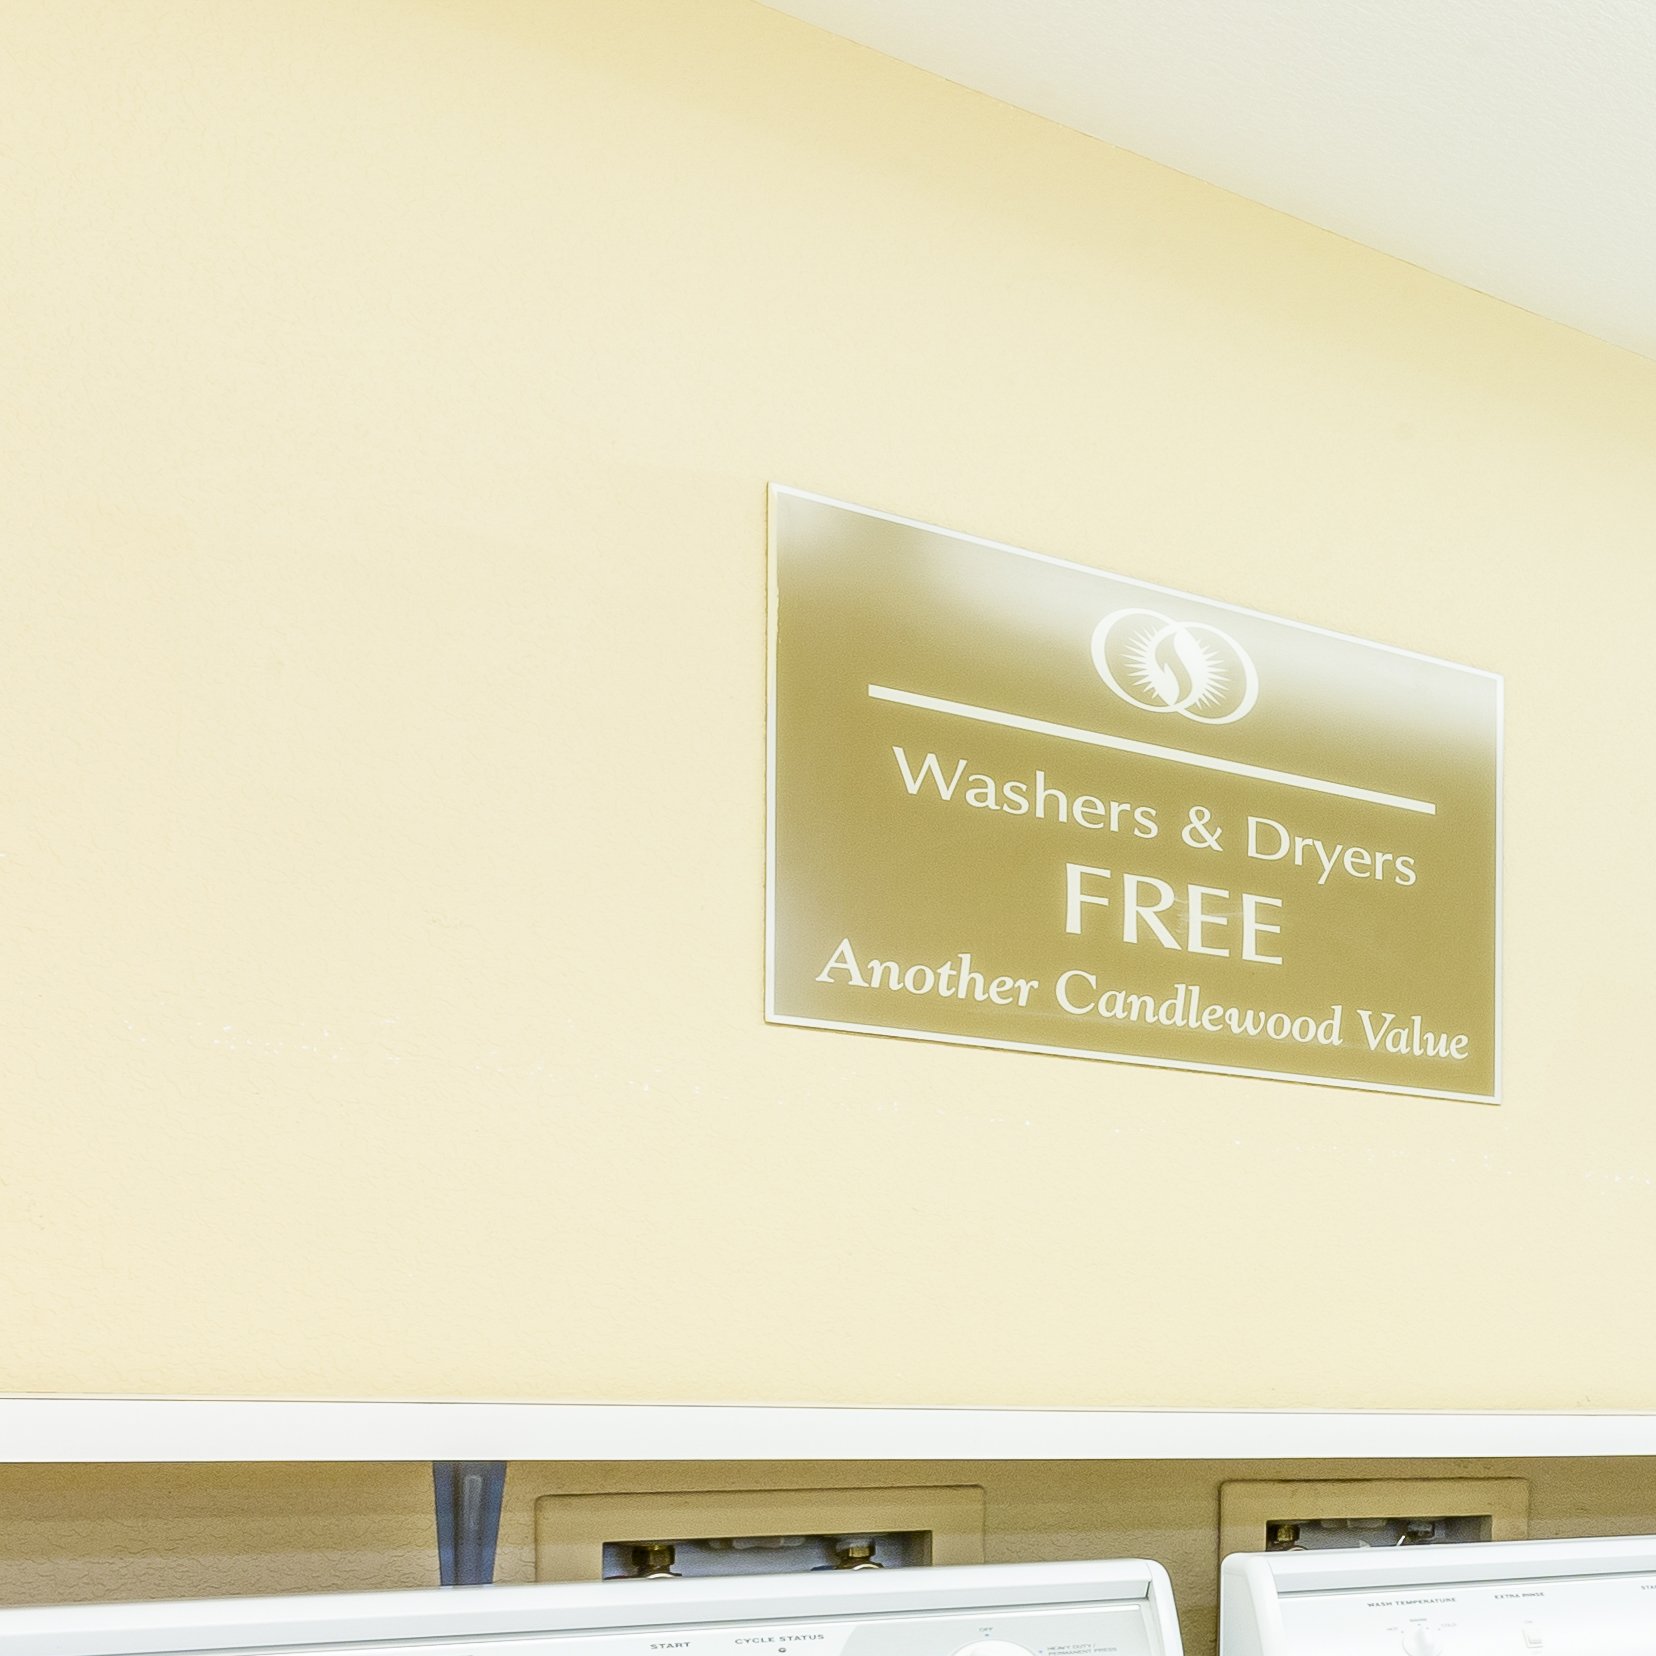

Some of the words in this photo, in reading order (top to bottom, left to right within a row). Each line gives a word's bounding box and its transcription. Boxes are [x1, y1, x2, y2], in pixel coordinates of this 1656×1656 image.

[893, 746, 1158, 839] Washers
[1181, 805, 1223, 852] &
[1247, 817, 1417, 886] Dryers
[1064, 862, 1283, 965] FREE
[815, 938, 1038, 1008] Another
[1055, 969, 1343, 1047] Candlewood
[1357, 1010, 1469, 1060] Value
[649, 1641, 691, 1650] START
[734, 1636, 775, 1645] CYCLE
[778, 1633, 825, 1642] STATUS
